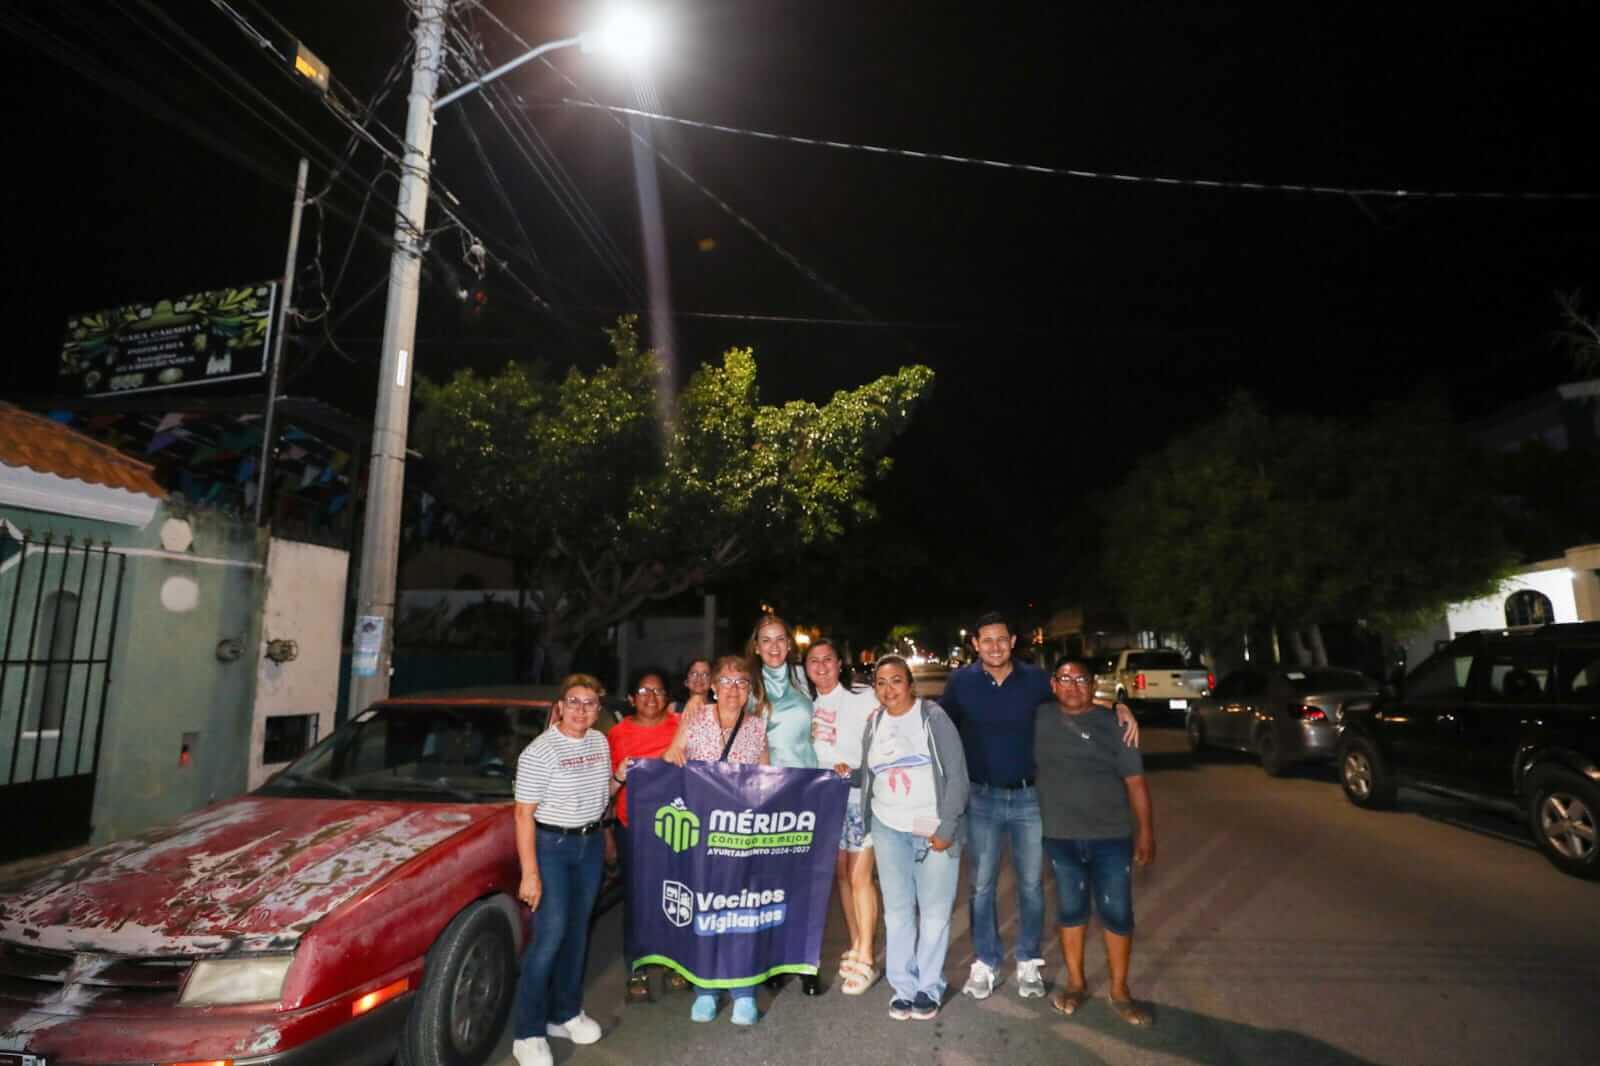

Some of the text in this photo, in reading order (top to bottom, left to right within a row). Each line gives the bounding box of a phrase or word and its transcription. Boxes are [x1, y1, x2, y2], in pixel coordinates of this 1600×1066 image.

[709, 809, 816, 834] MÉRIDA
[711, 835, 758, 846] CONTIGO
[777, 834, 809, 844] MEJOR
[707, 847, 769, 857] AYUNTAMIENTO
[696, 889, 785, 912] Vecinos
[697, 909, 783, 934] Vigilantes
